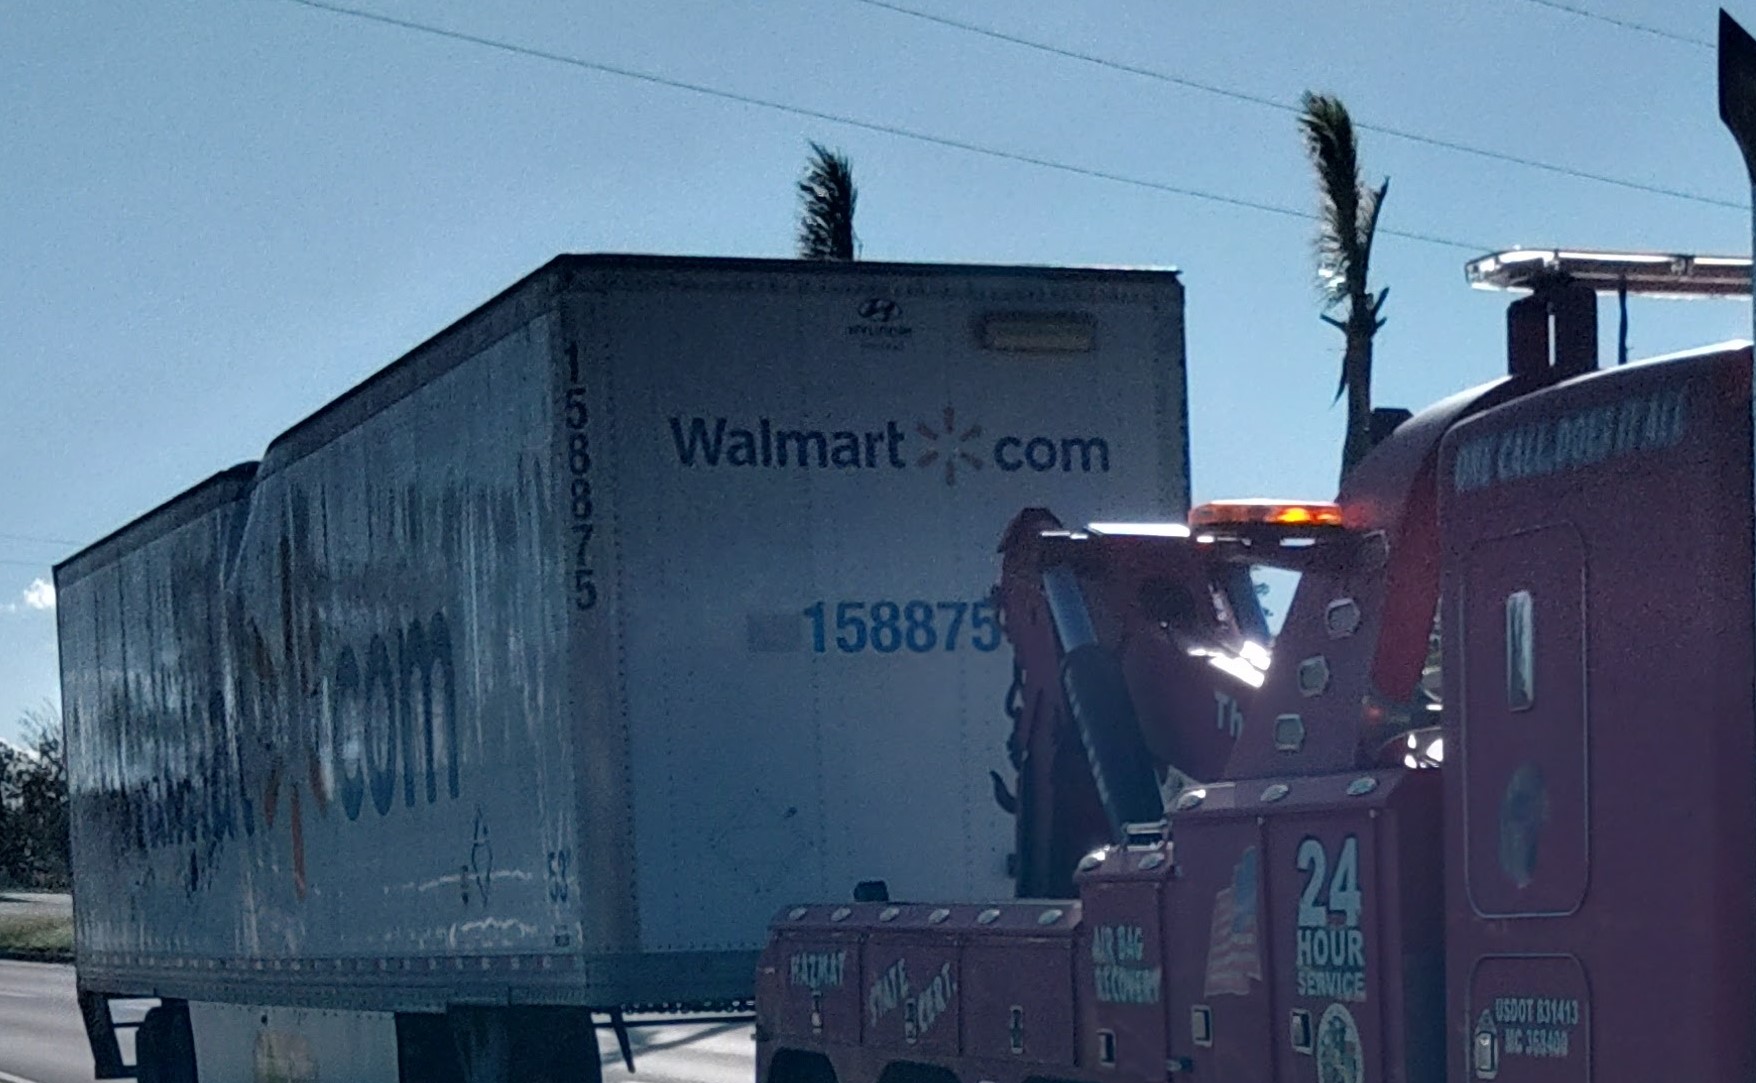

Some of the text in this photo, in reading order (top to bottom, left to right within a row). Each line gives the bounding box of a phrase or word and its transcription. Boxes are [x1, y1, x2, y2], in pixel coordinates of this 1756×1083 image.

[669, 416, 906, 471] Walmart
[804, 600, 1000, 653] 158875
[1296, 834, 1363, 928] 24
[1297, 930, 1366, 967] HOUR
[1297, 970, 1366, 1000] SERVICE
[1495, 997, 1534, 1024] USDOT
